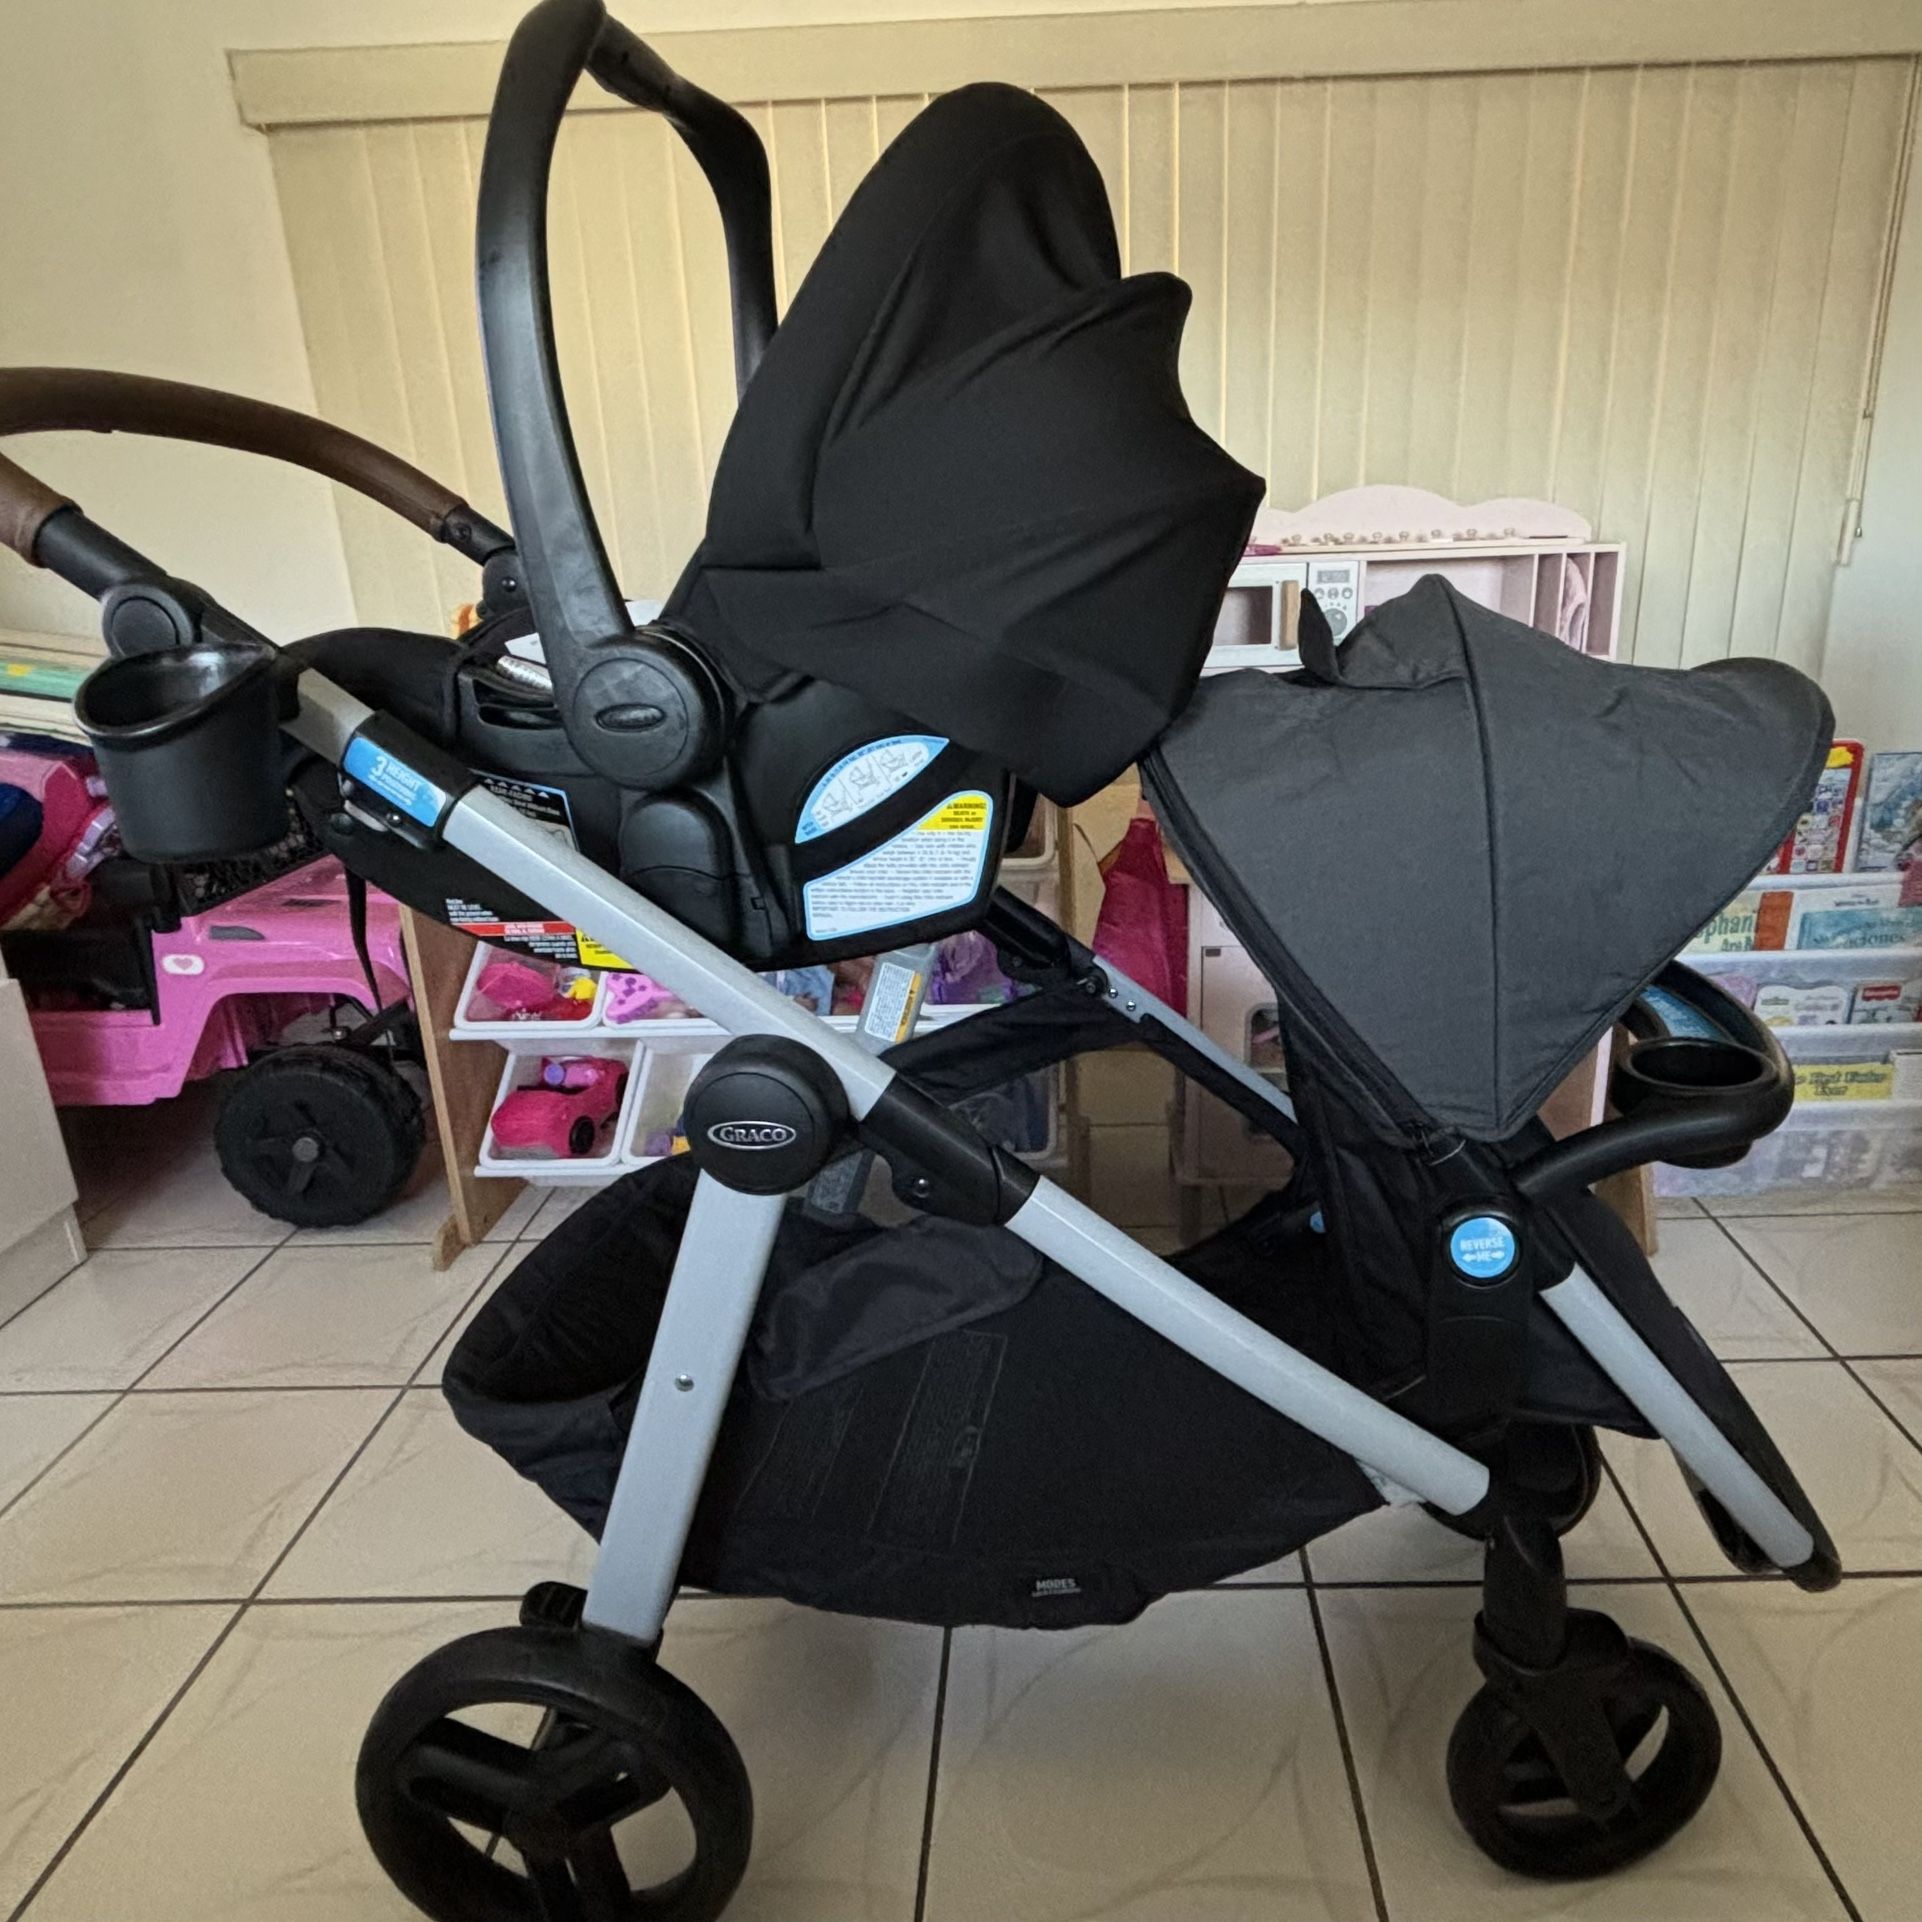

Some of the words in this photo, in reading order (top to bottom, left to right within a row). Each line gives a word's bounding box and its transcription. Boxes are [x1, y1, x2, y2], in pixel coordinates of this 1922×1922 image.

[370, 755, 388, 778] 3
[384, 761, 422, 793] HEIGHT
[720, 1126, 788, 1142] GRACO
[1460, 1236, 1505, 1252] REVERSE
[1476, 1250, 1491, 1262] ME
